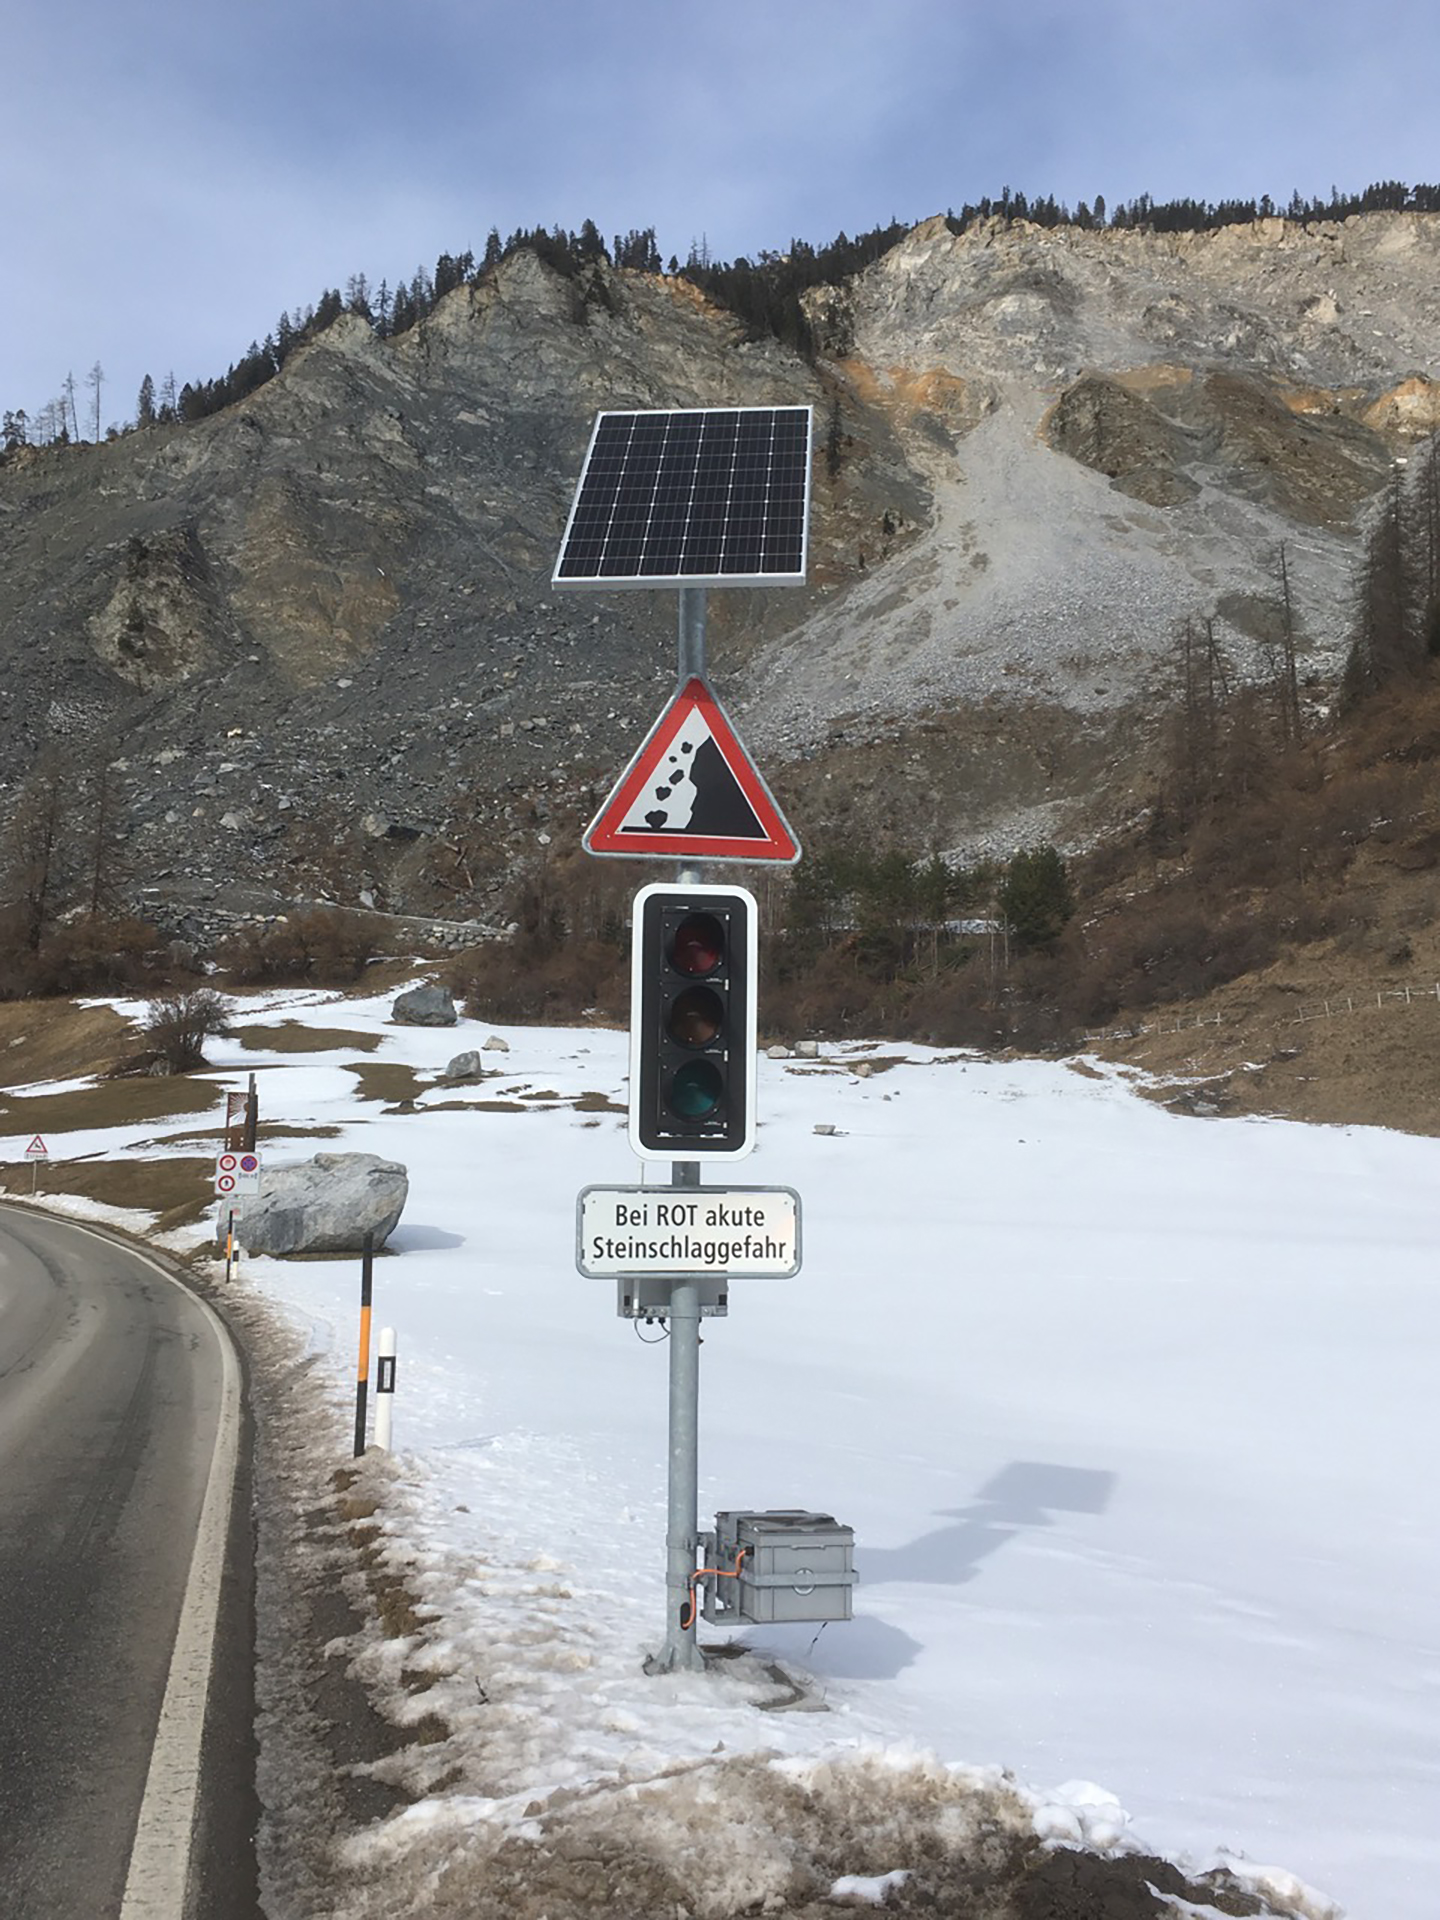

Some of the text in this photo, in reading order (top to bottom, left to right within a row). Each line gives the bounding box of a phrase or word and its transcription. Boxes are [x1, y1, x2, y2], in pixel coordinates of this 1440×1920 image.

[615, 1203, 765, 1227] Bei ROT akute
[592, 1235, 787, 1265] Steinschlaggefahr
